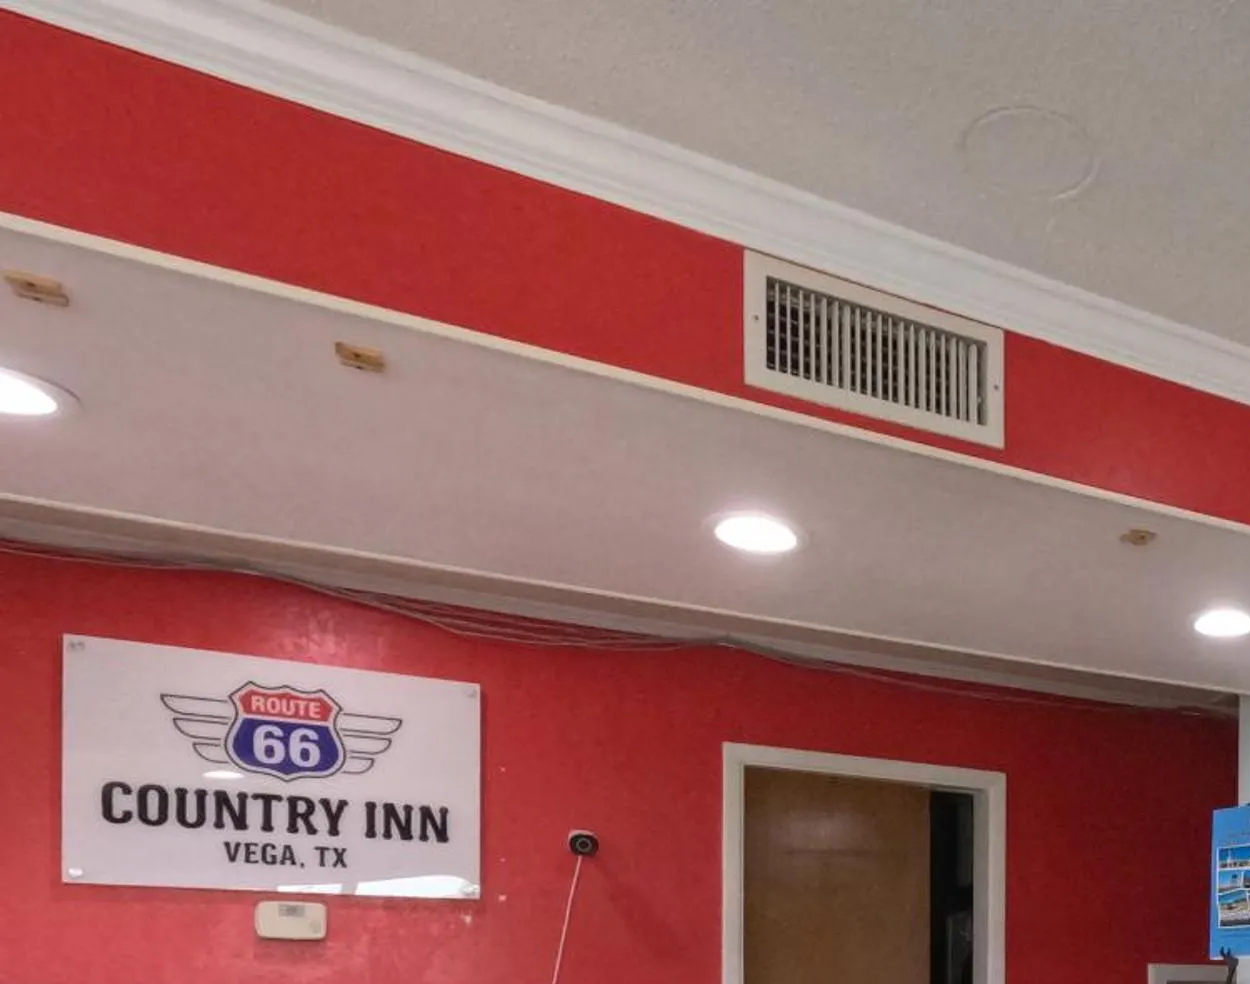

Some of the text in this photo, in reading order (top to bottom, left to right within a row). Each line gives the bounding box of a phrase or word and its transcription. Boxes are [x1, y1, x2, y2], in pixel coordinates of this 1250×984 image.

[251, 694, 322, 719] ROUTE
[252, 724, 320, 767] 66
[101, 781, 450, 843] COUNTRY INN
[224, 841, 348, 869] VEGA, TX
